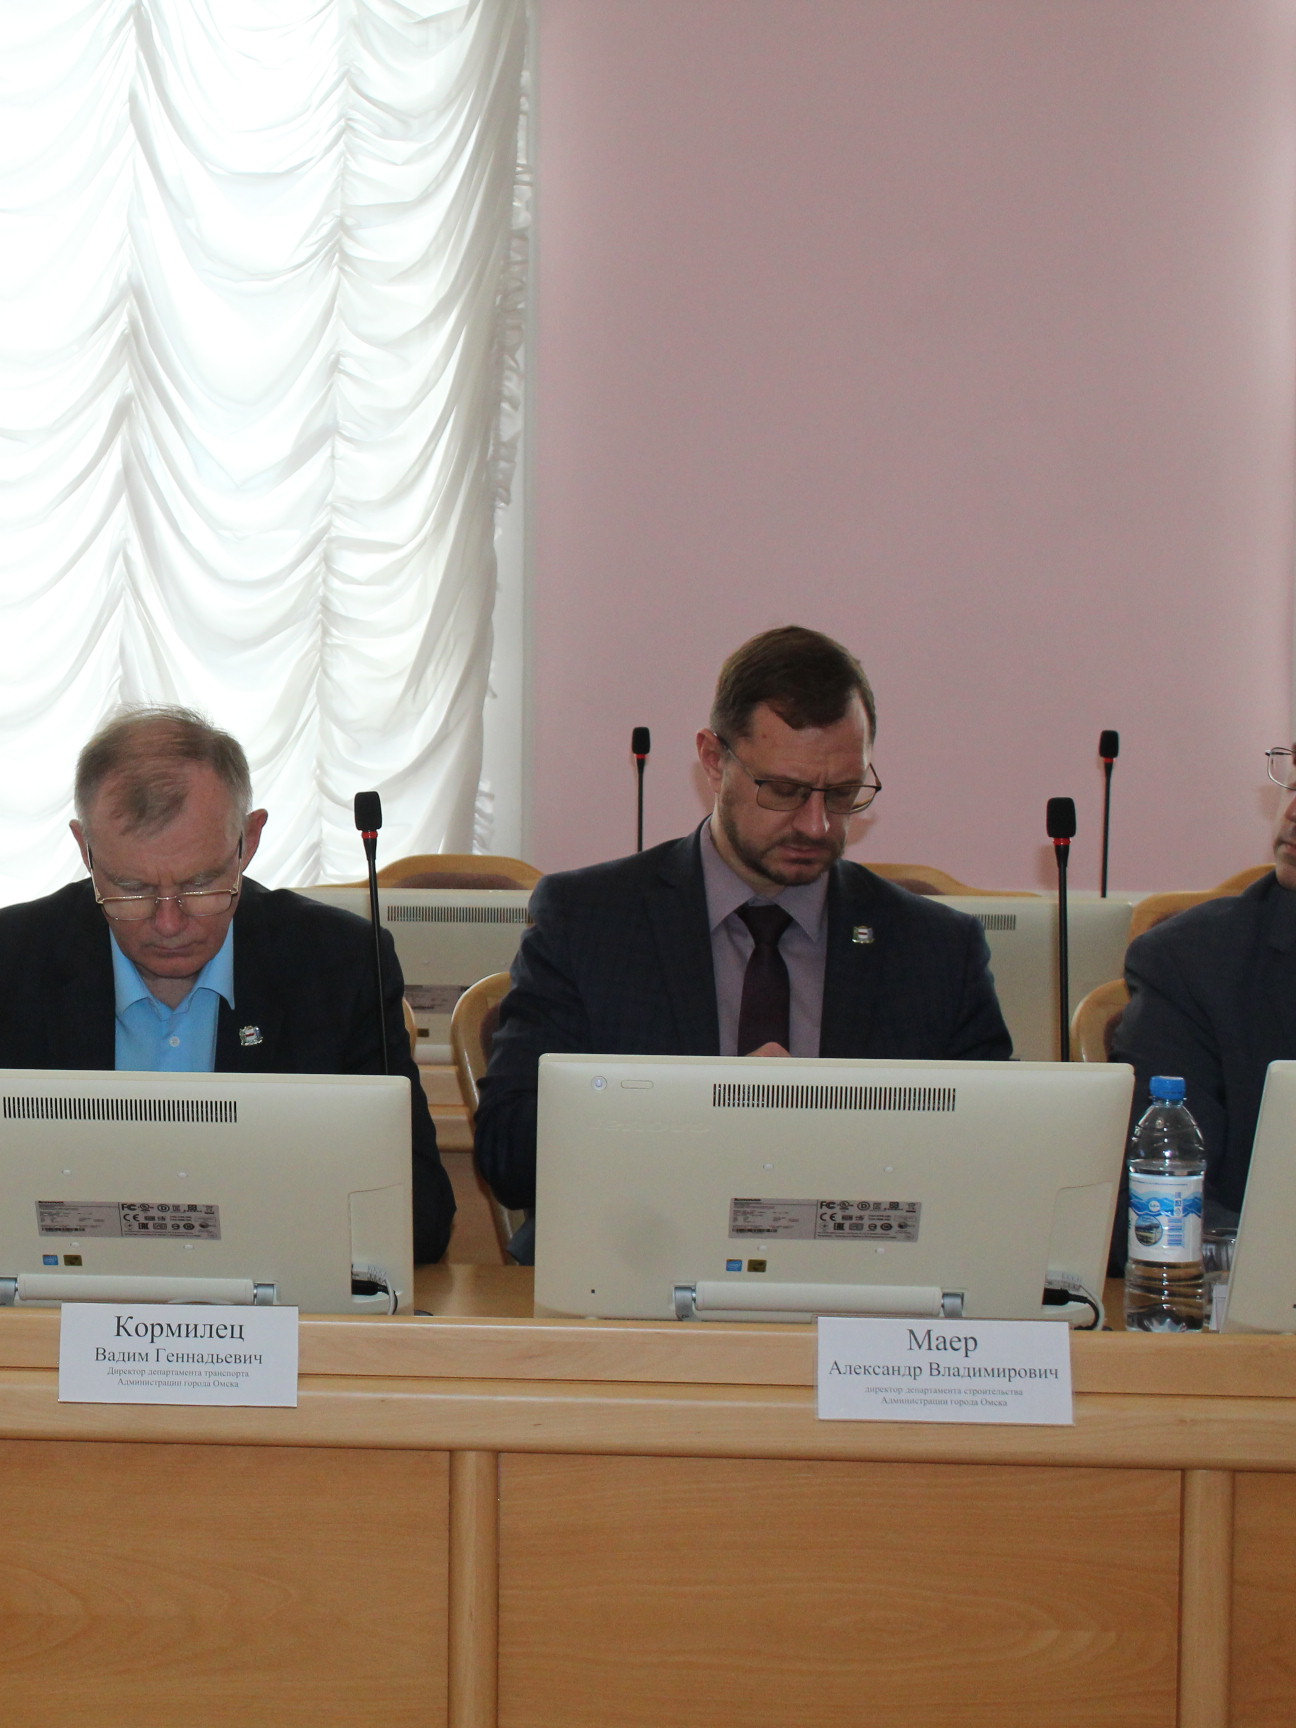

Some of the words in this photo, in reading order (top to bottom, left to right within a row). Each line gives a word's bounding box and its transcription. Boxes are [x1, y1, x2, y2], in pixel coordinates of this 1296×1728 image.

[114, 1316, 244, 1343] Кормилец
[906, 1328, 978, 1358] Маер
[95, 1347, 149, 1362] Вадим
[155, 1348, 263, 1366] Геннадьевич
[107, 1367, 146, 1377] Директор
[148, 1369, 202, 1378] департамента
[204, 1370, 249, 1378] транспорта
[828, 1360, 923, 1380] Александр
[928, 1362, 1059, 1382] Владимирович
[117, 1378, 182, 1388] Администрации
[184, 1380, 211, 1388] города
[212, 1380, 239, 1388] Омска
[864, 1386, 904, 1394] директор
[905, 1387, 962, 1395] департамента
[881, 1396, 948, 1406] Администрации
[950, 1398, 978, 1406] города
[980, 1398, 1008, 1406] Омска
